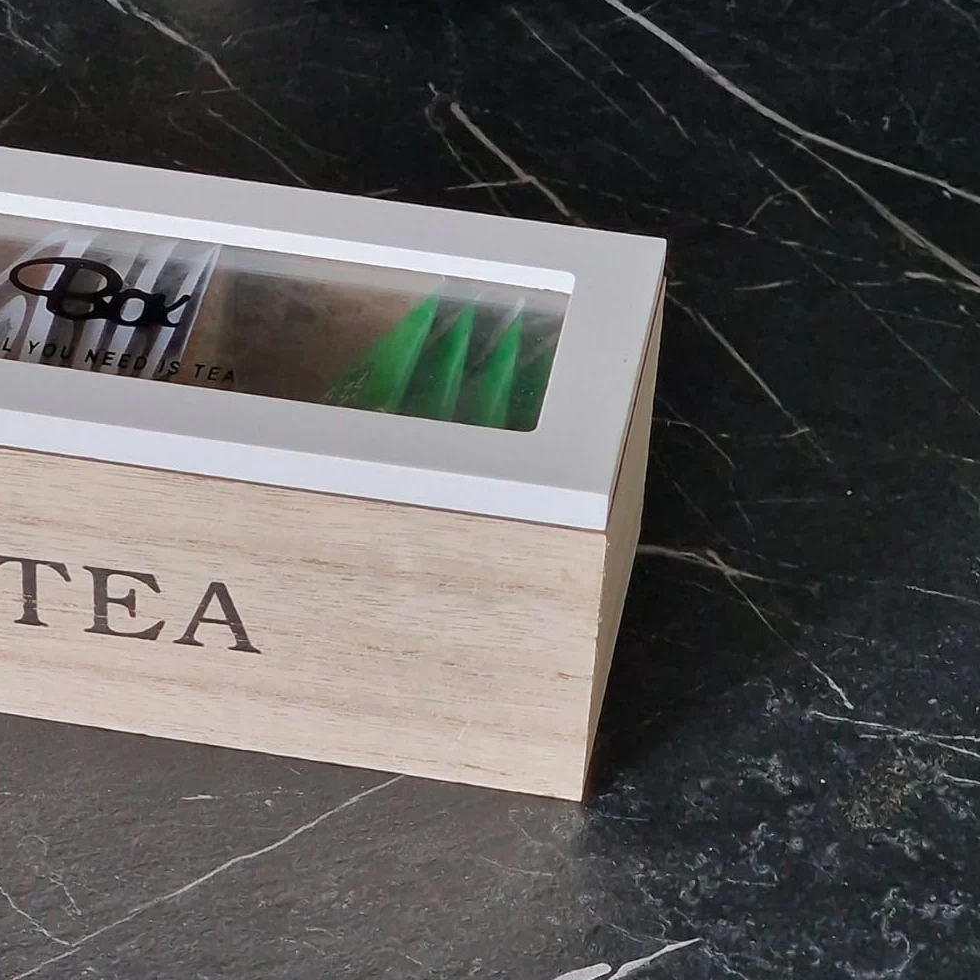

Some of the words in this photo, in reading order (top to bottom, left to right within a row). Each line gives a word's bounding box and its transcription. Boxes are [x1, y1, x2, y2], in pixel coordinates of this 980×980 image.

[9, 256, 192, 328] Box
[28, 340, 74, 359] YOU
[84, 348, 148, 371] NEED
[158, 360, 181, 376] IS
[194, 363, 235, 382] TEA
